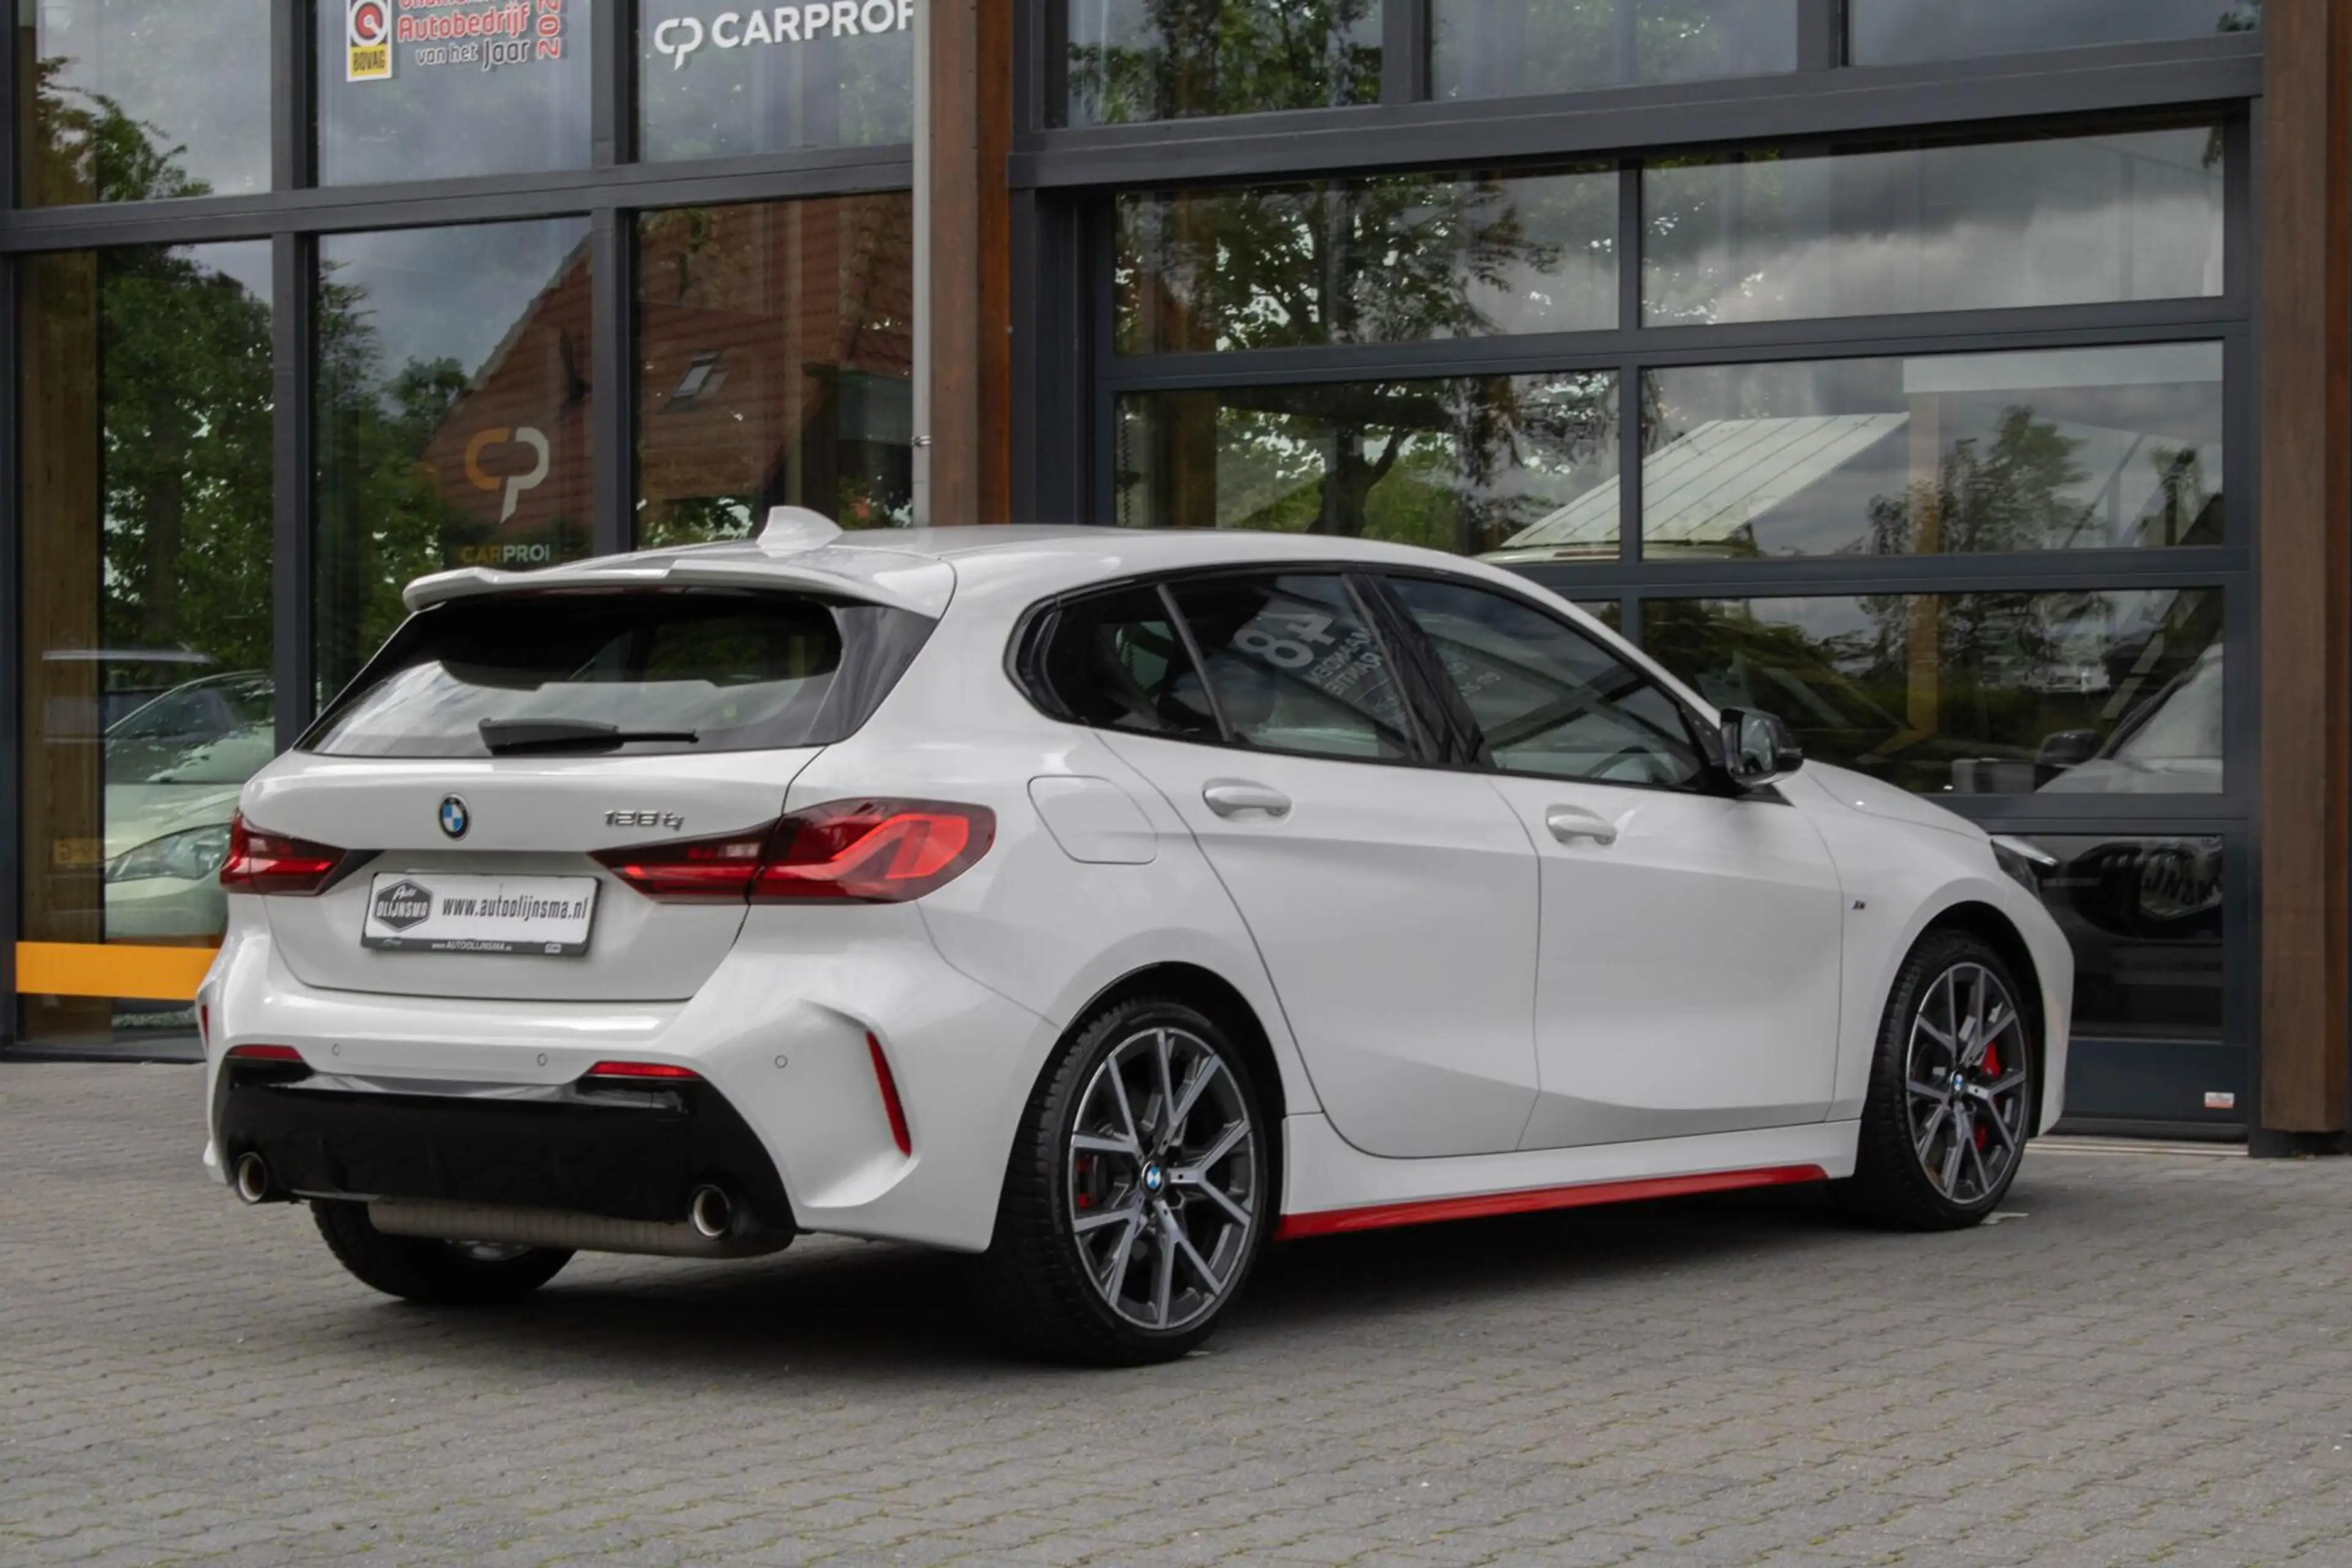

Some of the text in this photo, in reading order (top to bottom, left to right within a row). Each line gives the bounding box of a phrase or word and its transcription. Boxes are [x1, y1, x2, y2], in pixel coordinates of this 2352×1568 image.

[398, 3, 530, 42] Autobedrijf
[353, 50, 385, 72] BOVAG
[415, 47, 446, 66] van
[448, 42, 478, 62] het
[442, 894, 589, 921] www.autoolijnsma.nl
